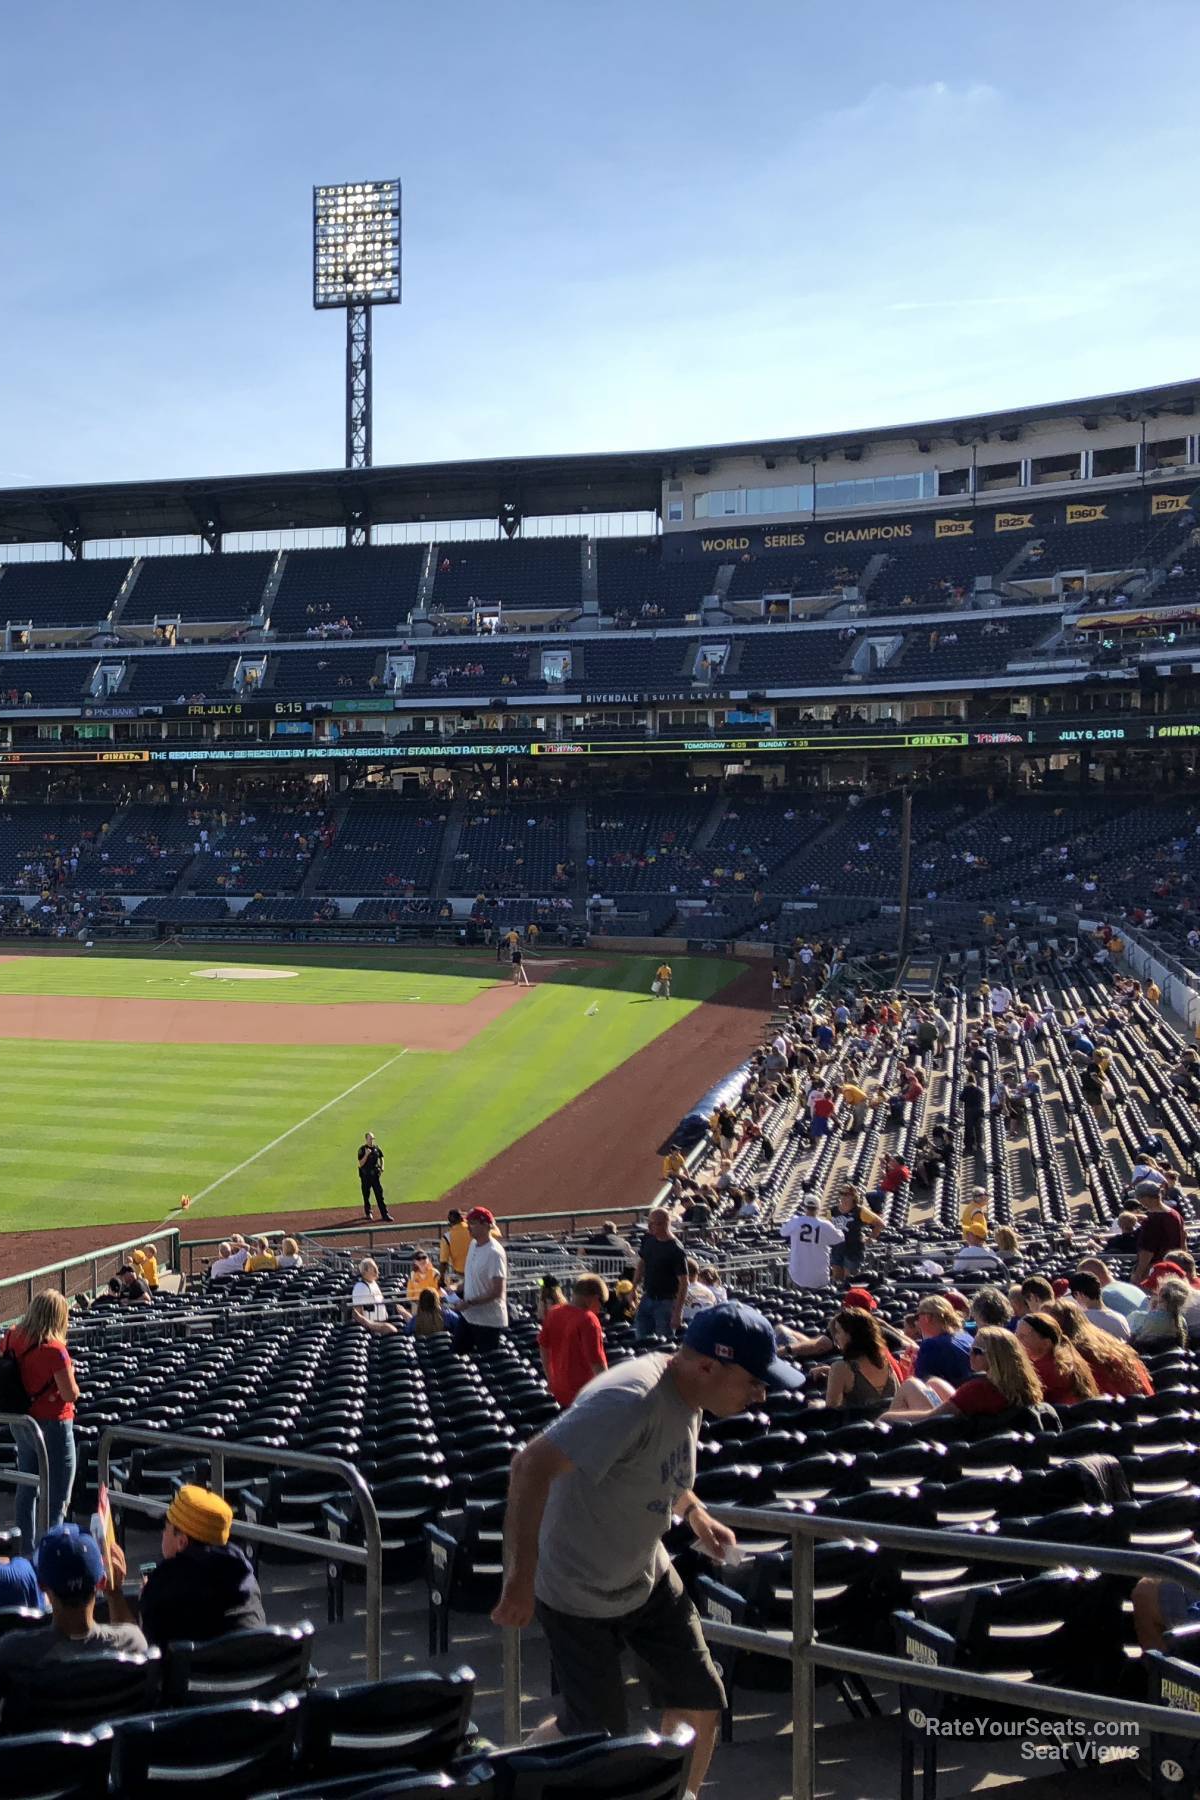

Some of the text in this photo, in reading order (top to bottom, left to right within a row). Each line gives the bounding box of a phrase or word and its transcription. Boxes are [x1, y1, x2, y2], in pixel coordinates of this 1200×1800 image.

[1155, 498, 1181, 510] 1971
[1069, 508, 1098, 520] 1960
[998, 516, 1025, 528] 1925
[938, 523, 966, 534] 1909
[701, 524, 913, 551] WORLD SERIES CHAMPIONS
[586, 692, 725, 703] RIVENDALE SUITE LEVEL
[94, 707, 135, 717] PNC BANK
[208, 705, 232, 714] JULY
[275, 702, 302, 713] 6:15
[1059, 731, 1084, 740] JULY
[1098, 729, 1125, 738] 2018
[684, 742, 725, 750] TOMORROW
[758, 741, 788, 749] SUNDAY
[150, 751, 168, 760] THE
[407, 746, 463, 756] STANDARD
[800, 1223, 820, 1244] 21
